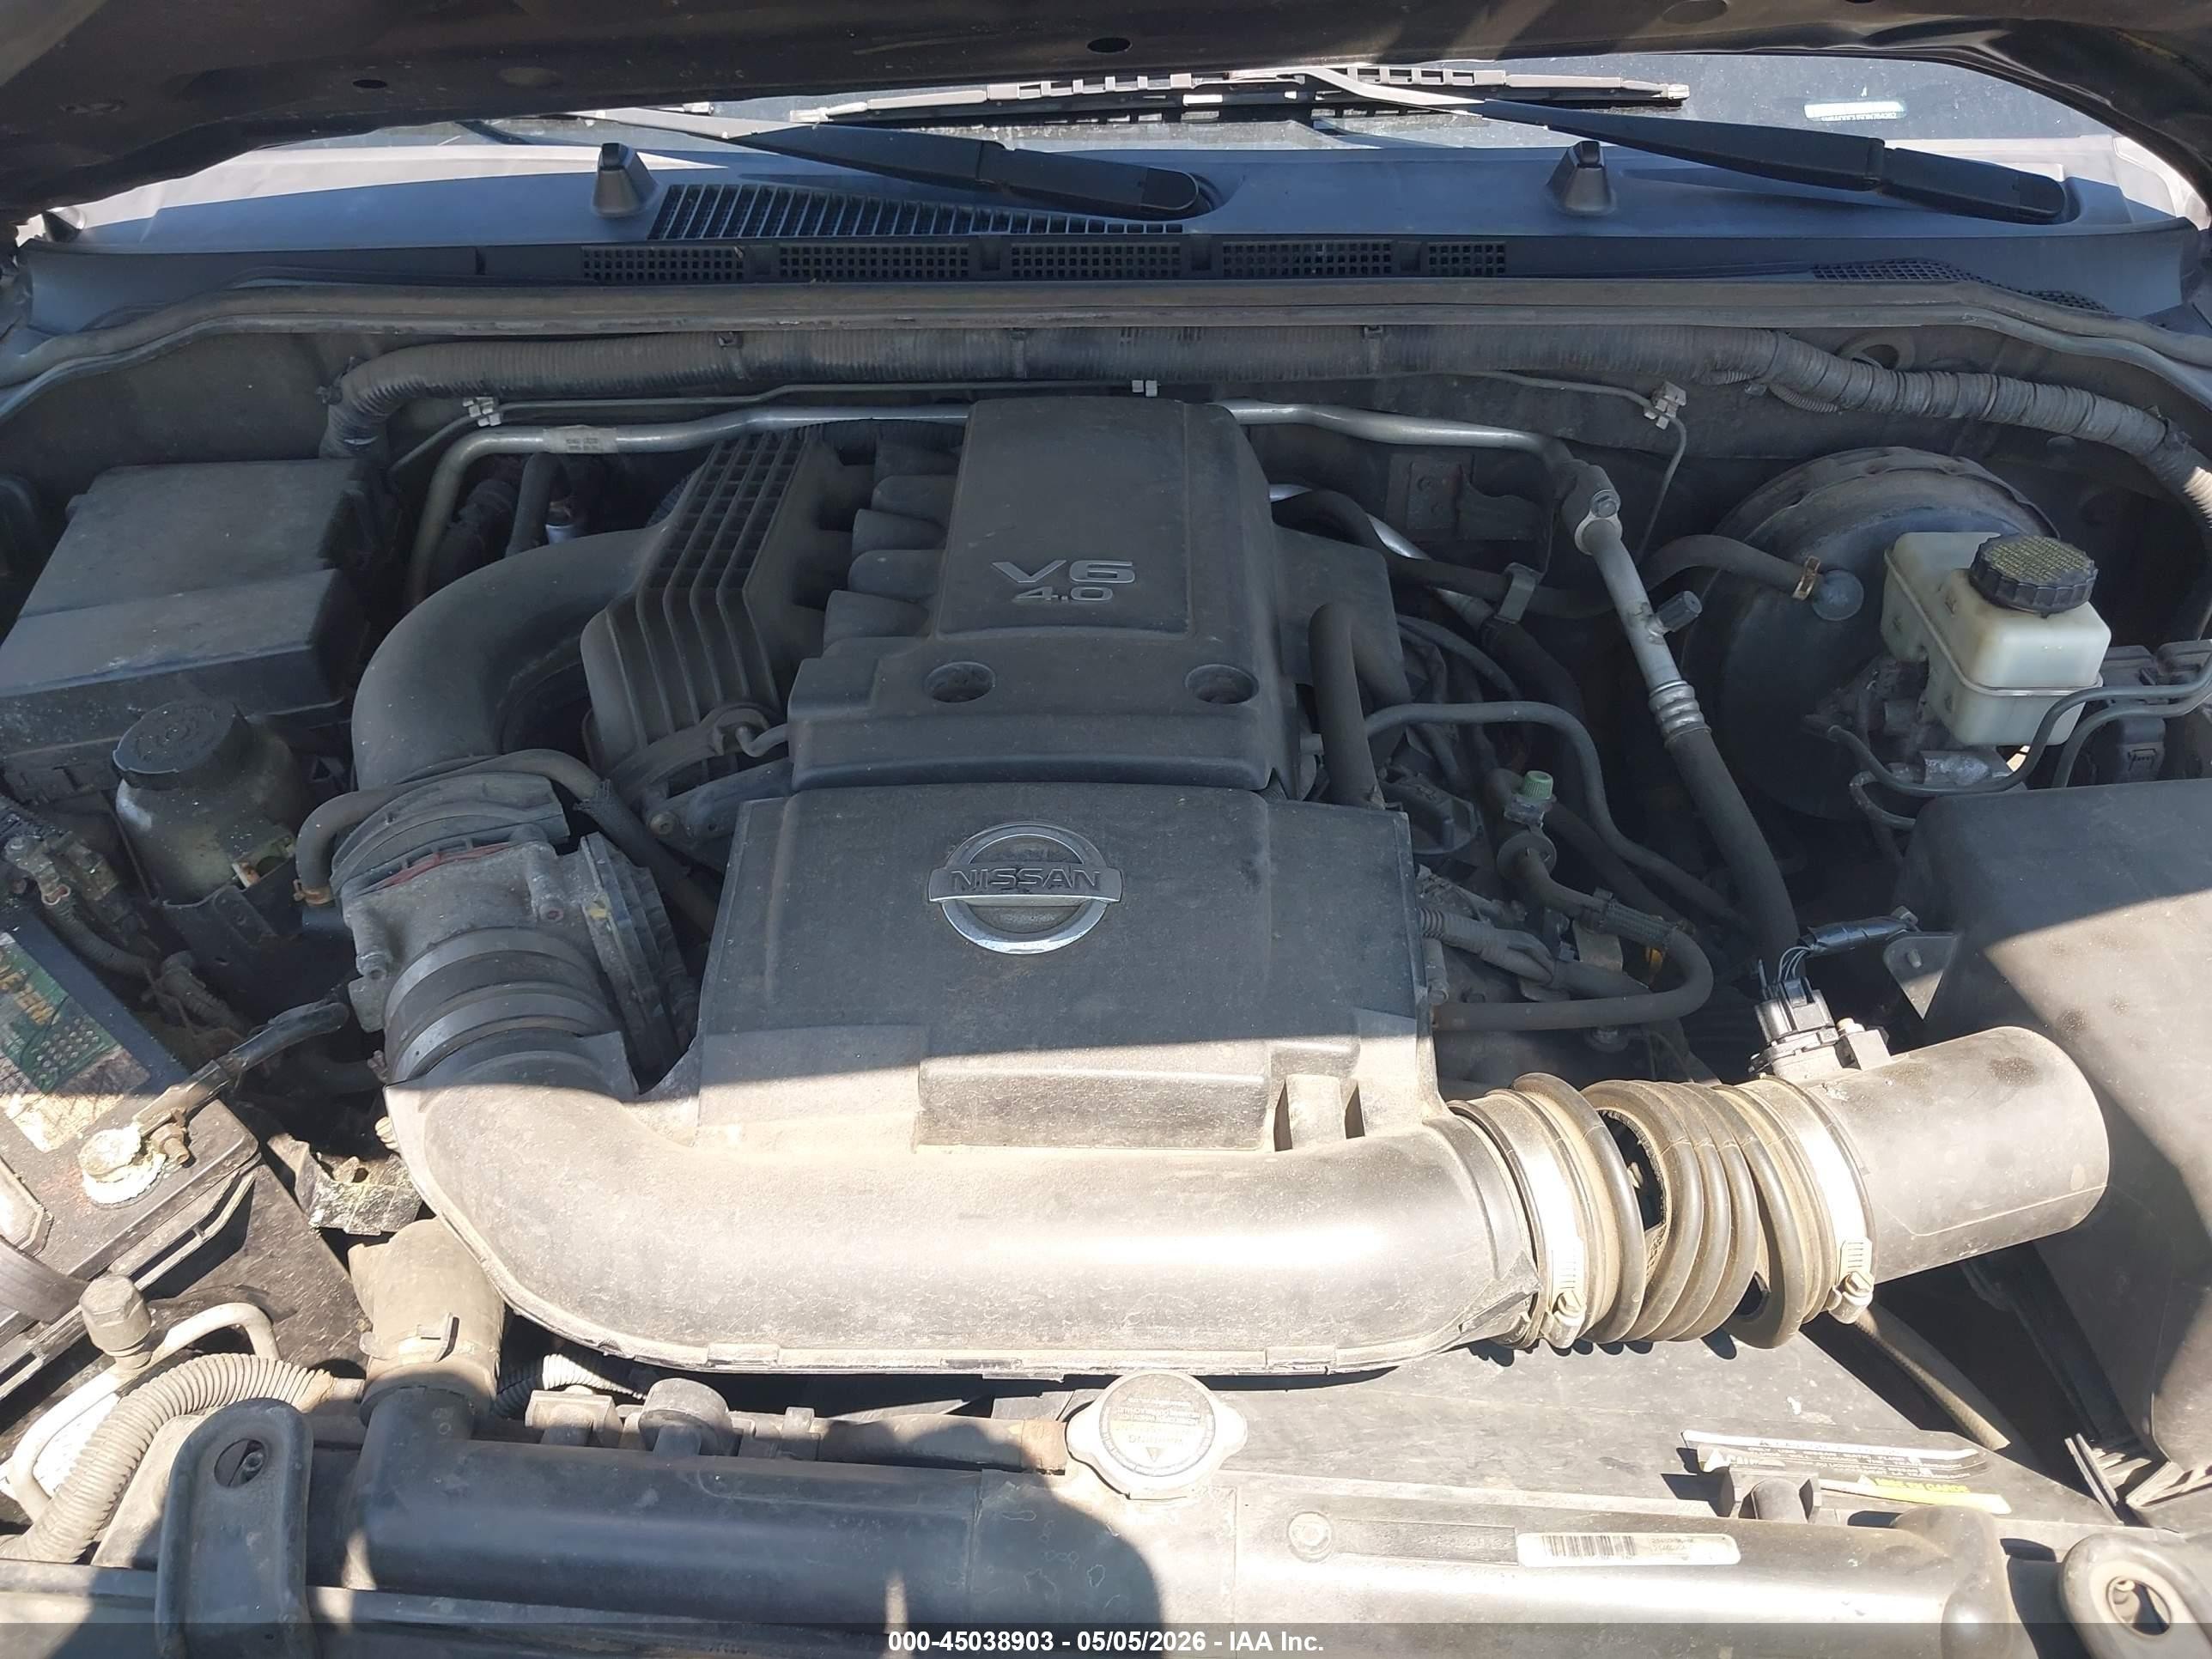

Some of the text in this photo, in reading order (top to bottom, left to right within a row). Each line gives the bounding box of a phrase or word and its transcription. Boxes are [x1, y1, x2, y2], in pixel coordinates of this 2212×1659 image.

[992, 560, 1135, 584] V6
[1014, 586, 1113, 601] 4.0
[951, 867, 1102, 890] NISSAN
